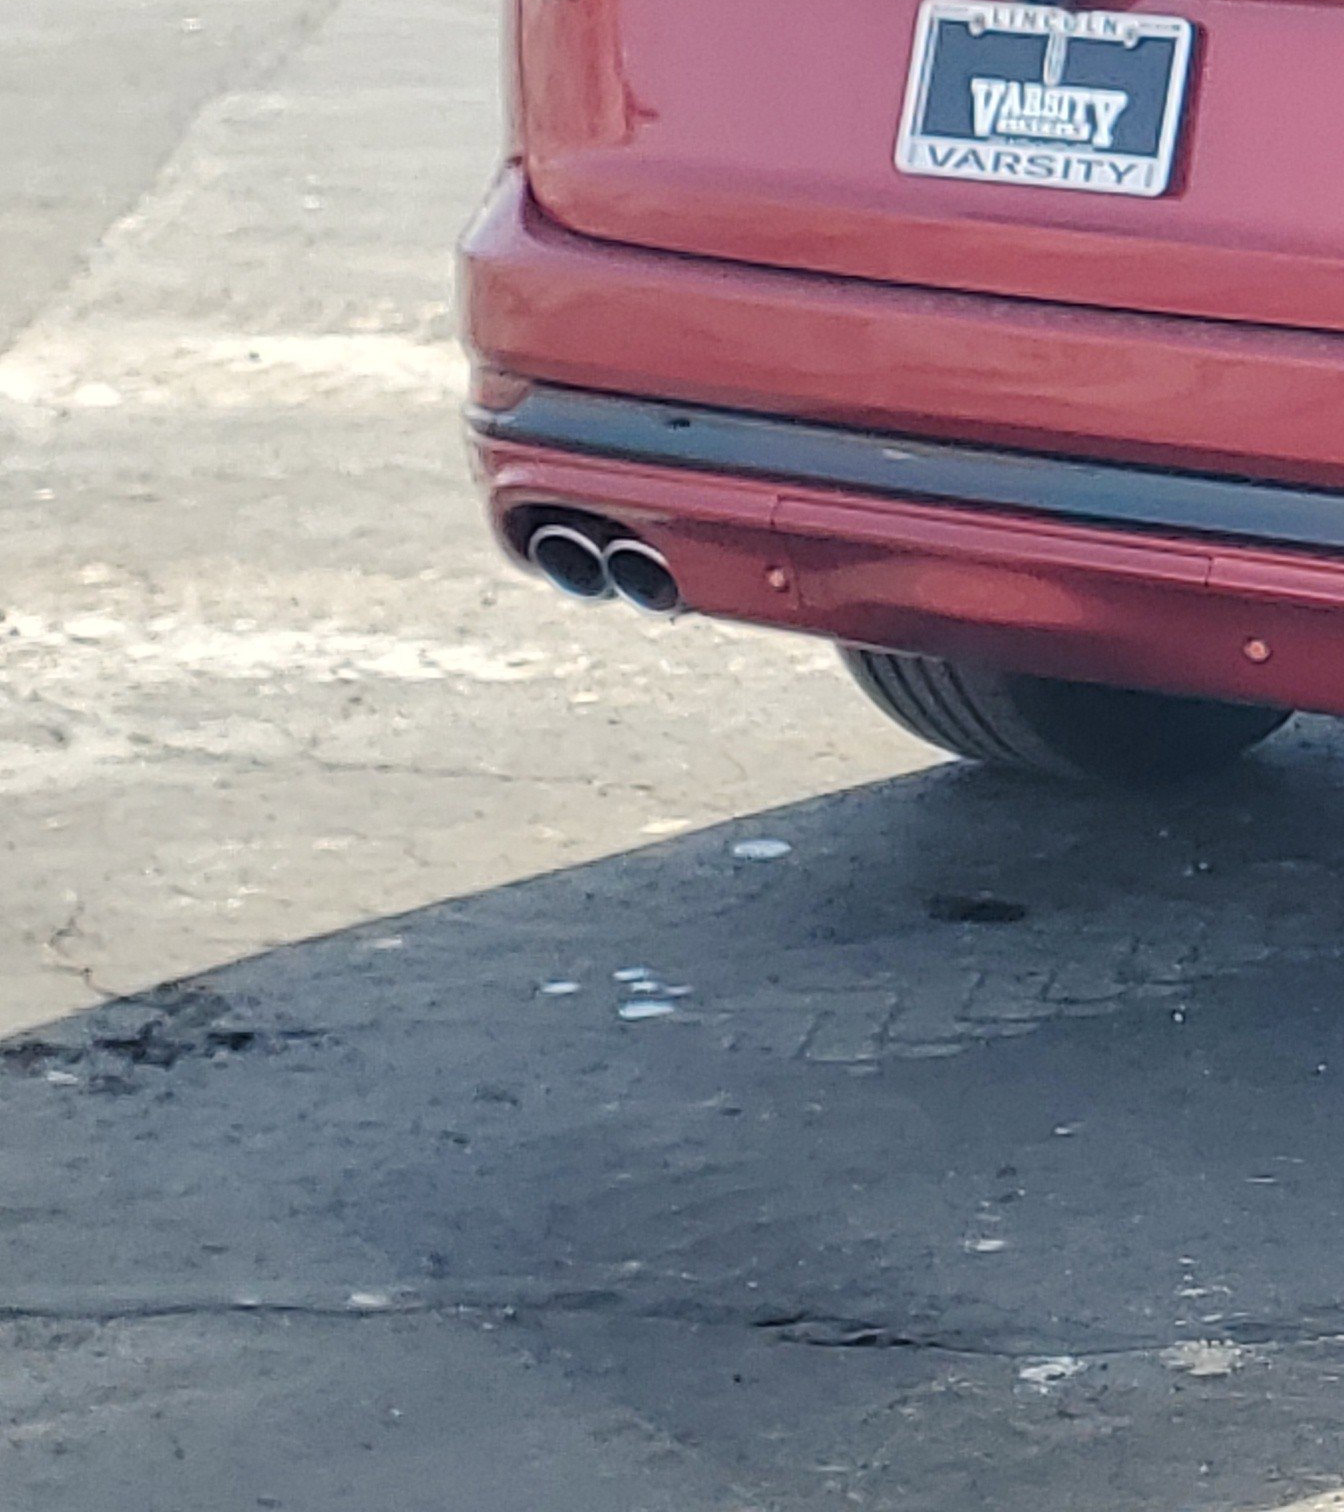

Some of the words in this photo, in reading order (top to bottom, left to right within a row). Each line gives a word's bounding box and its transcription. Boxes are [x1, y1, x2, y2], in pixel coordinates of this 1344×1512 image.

[991, 6, 1118, 37] LINCOLN
[970, 76, 1129, 148] VARSITY
[927, 143, 1139, 186] VARSITY
